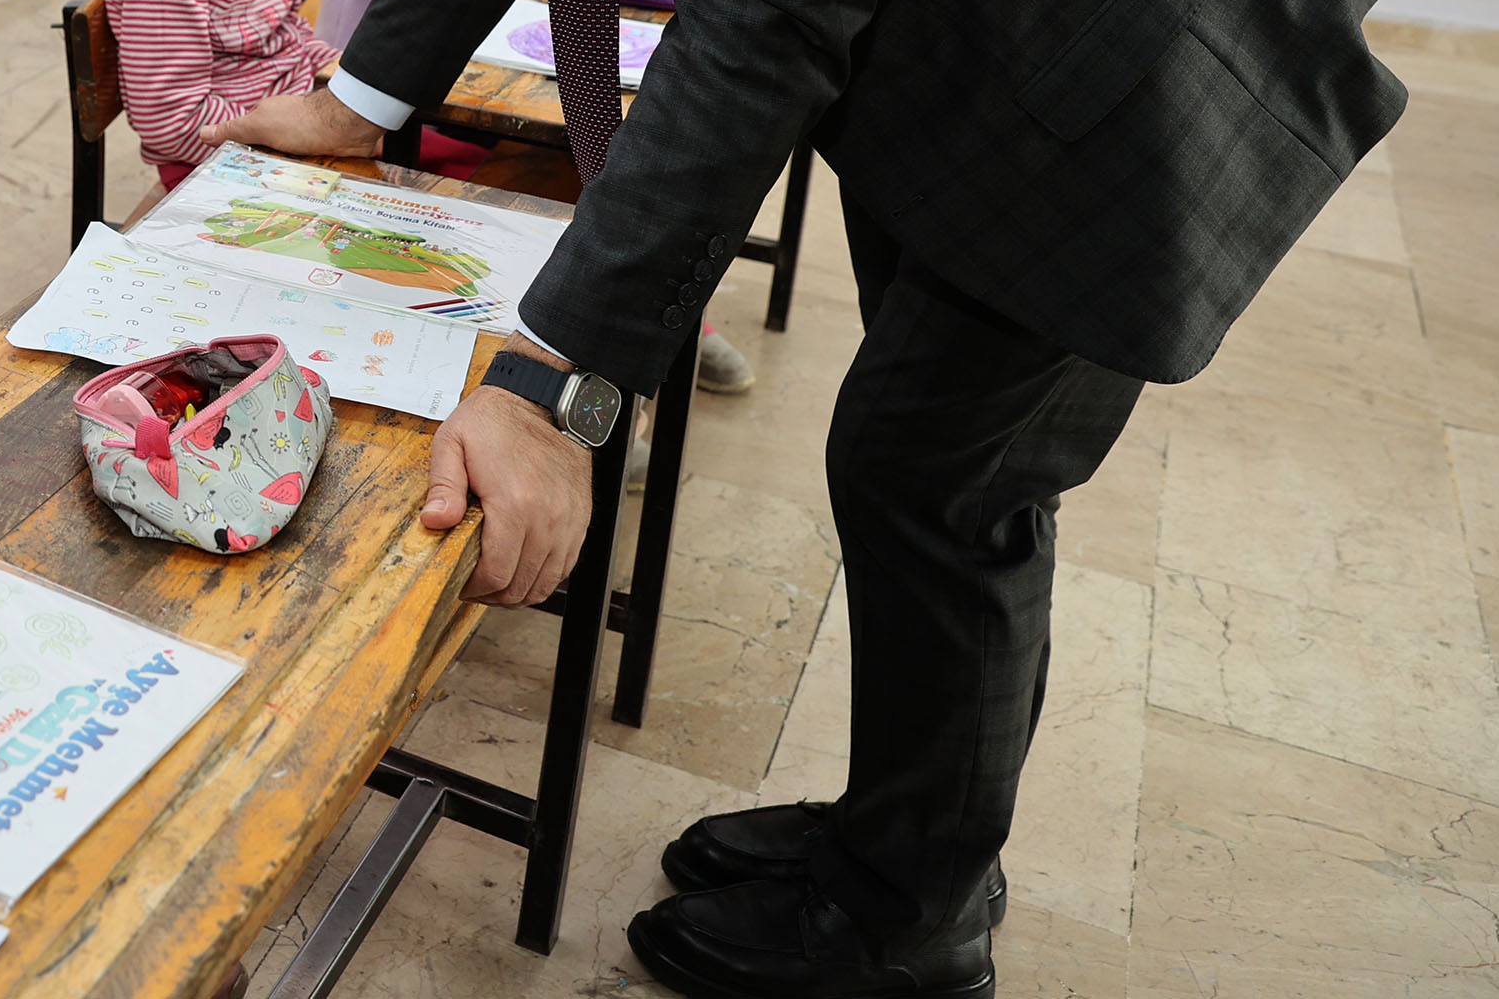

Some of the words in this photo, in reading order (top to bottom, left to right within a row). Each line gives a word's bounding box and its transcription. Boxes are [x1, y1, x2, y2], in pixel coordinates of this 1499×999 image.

[362, 192, 441, 212] Mehmet
[376, 210, 420, 224] Boyama
[84, 679, 106, 693] ve
[102, 653, 180, 716] Ayşe
